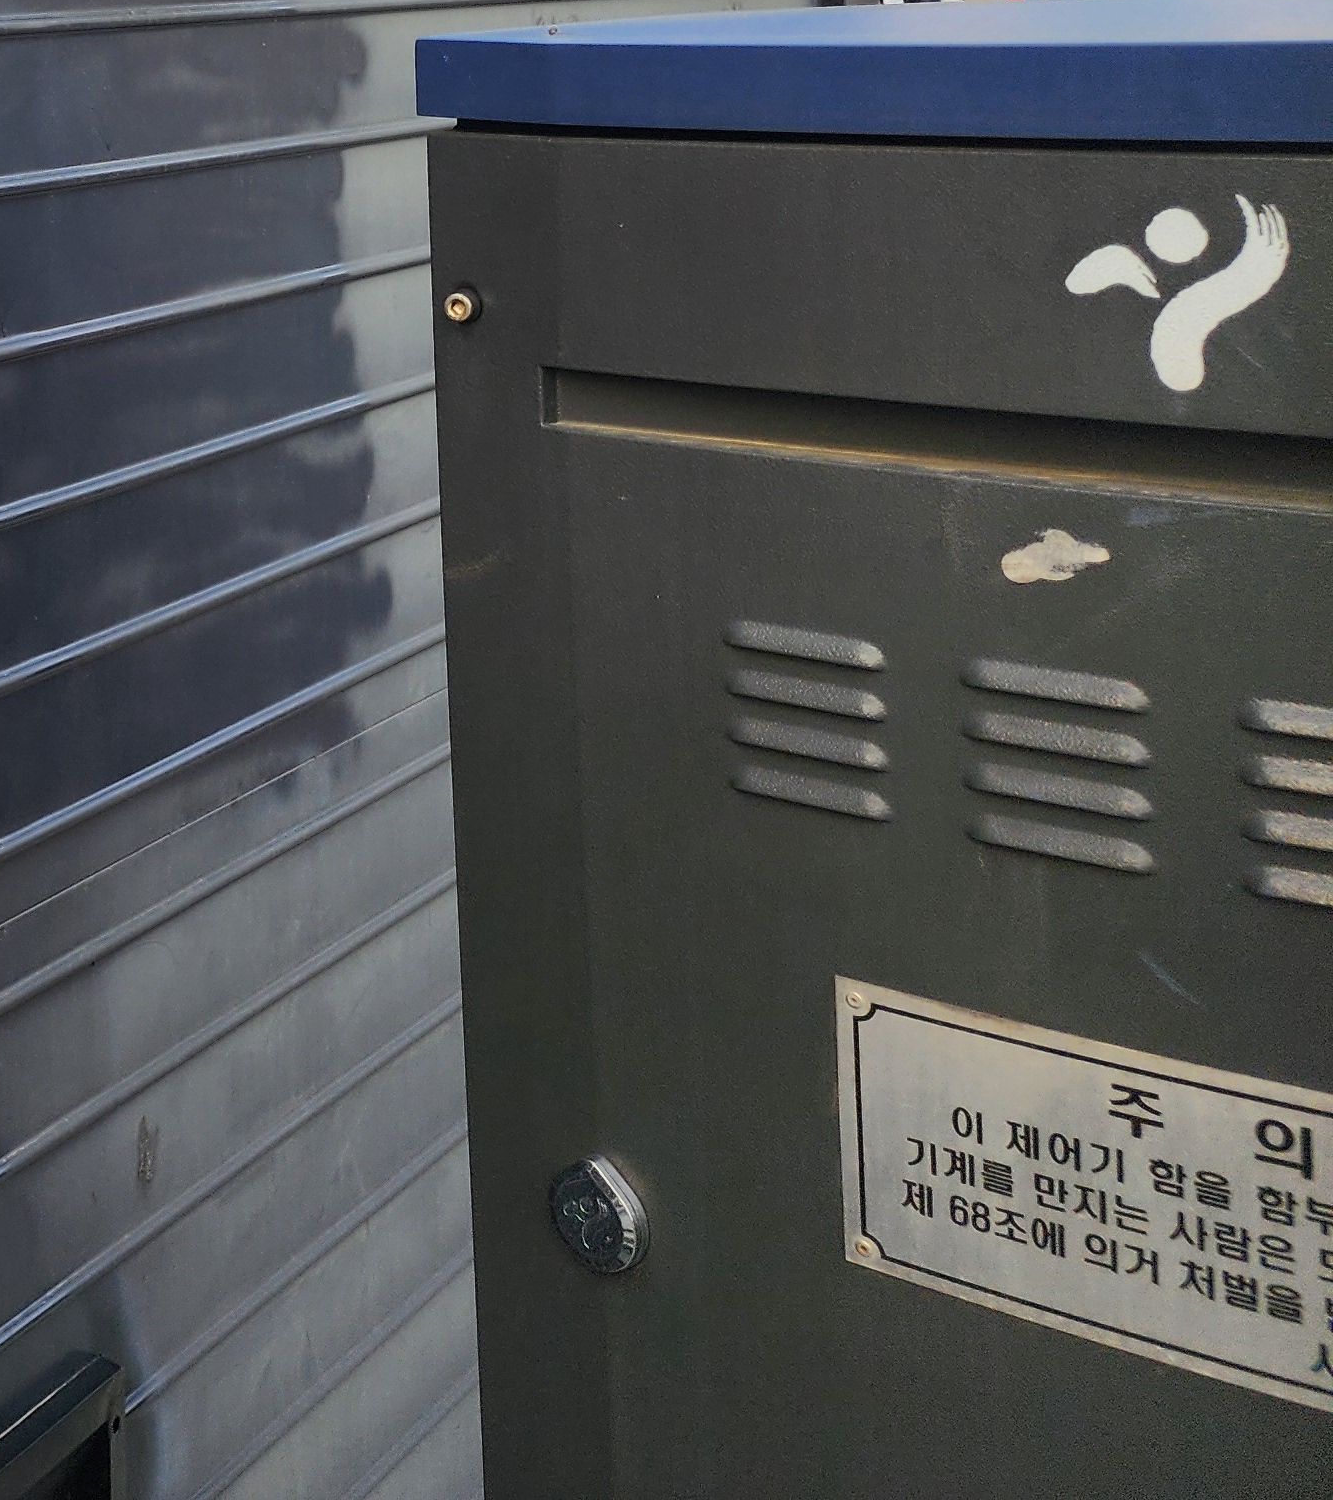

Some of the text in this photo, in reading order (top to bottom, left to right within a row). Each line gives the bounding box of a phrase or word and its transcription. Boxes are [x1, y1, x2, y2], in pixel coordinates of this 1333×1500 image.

[951, 1106, 983, 1145] 이
[1005, 1120, 1125, 1184] 제어기
[1148, 1158, 1231, 1212] 함을
[1108, 1083, 1314, 1181] 주 의
[900, 1179, 933, 1219] 제
[948, 1195, 1066, 1259] 68조에
[1083, 1233, 1161, 1287] 의거
[1178, 1259, 1303, 1325] 처벌을
[906, 1136, 1014, 1198] 기계를
[1033, 1174, 1149, 1236] 만지는
[1169, 1210, 1295, 1275] 사람은
